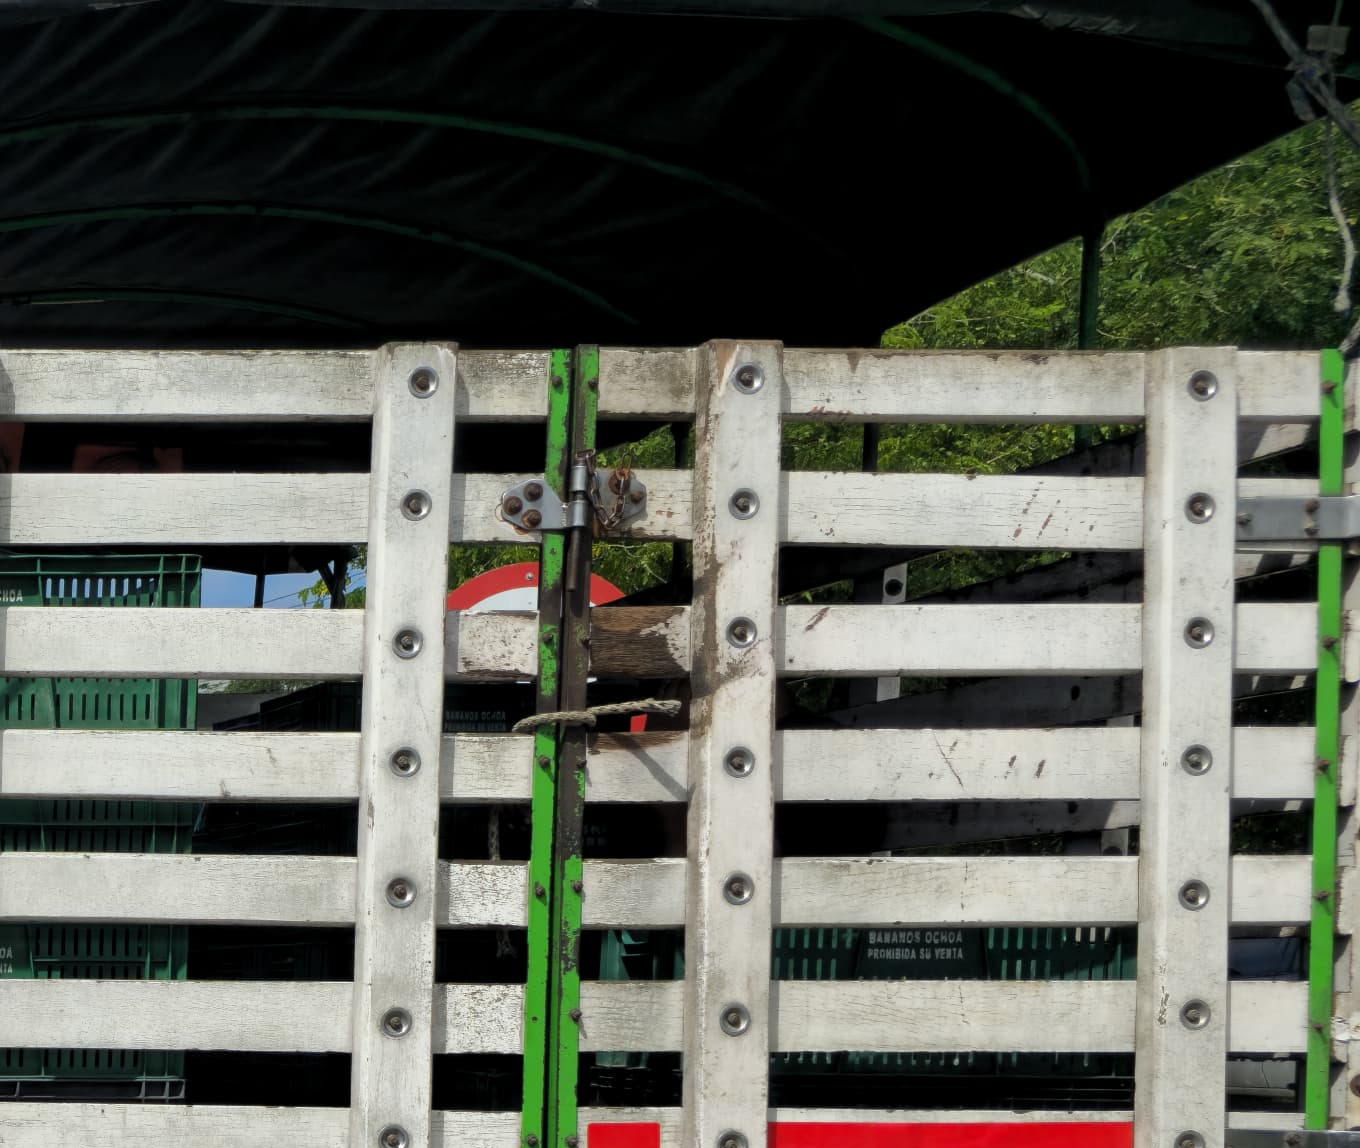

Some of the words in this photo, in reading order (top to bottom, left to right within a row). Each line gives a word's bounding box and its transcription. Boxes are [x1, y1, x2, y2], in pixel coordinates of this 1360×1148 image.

[868, 931, 920, 944] BANANOS
[925, 931, 963, 944] OCHOA
[867, 948, 916, 960] PROHIBIDA
[920, 948, 931, 960] SU
[934, 948, 963, 960] VENTA
